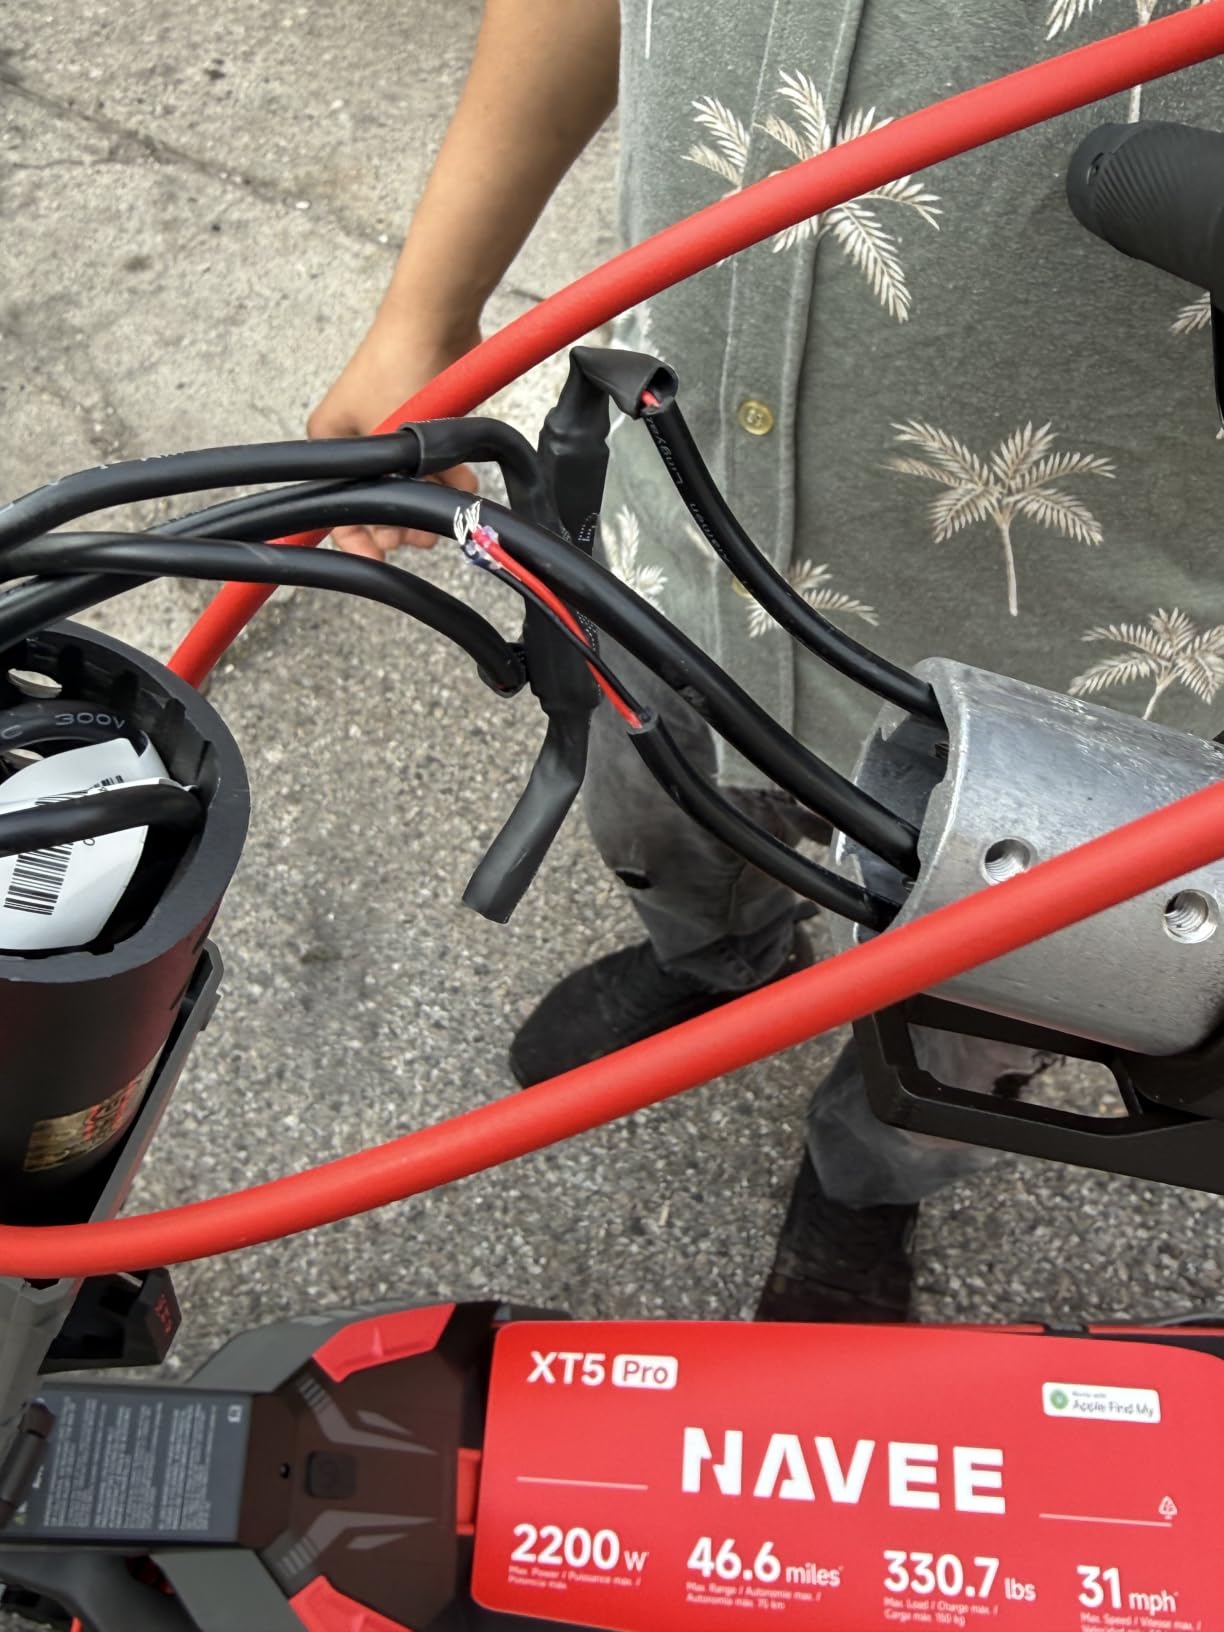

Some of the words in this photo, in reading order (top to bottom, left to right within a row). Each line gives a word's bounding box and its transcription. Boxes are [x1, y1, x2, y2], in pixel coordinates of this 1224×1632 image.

[54, 712, 125, 729] 300V
[527, 1351, 606, 1387] XT5
[622, 1360, 669, 1385] Pro
[682, 1426, 1006, 1515] NAVEE
[511, 1523, 620, 1570] 2200
[687, 1536, 782, 1583] 46.6
[785, 1563, 841, 1588] miles
[883, 1549, 1000, 1599] 330.7
[1004, 1577, 1037, 1603] lbs
[1076, 1564, 1123, 1609] 31
[1128, 1589, 1176, 1616] mph
